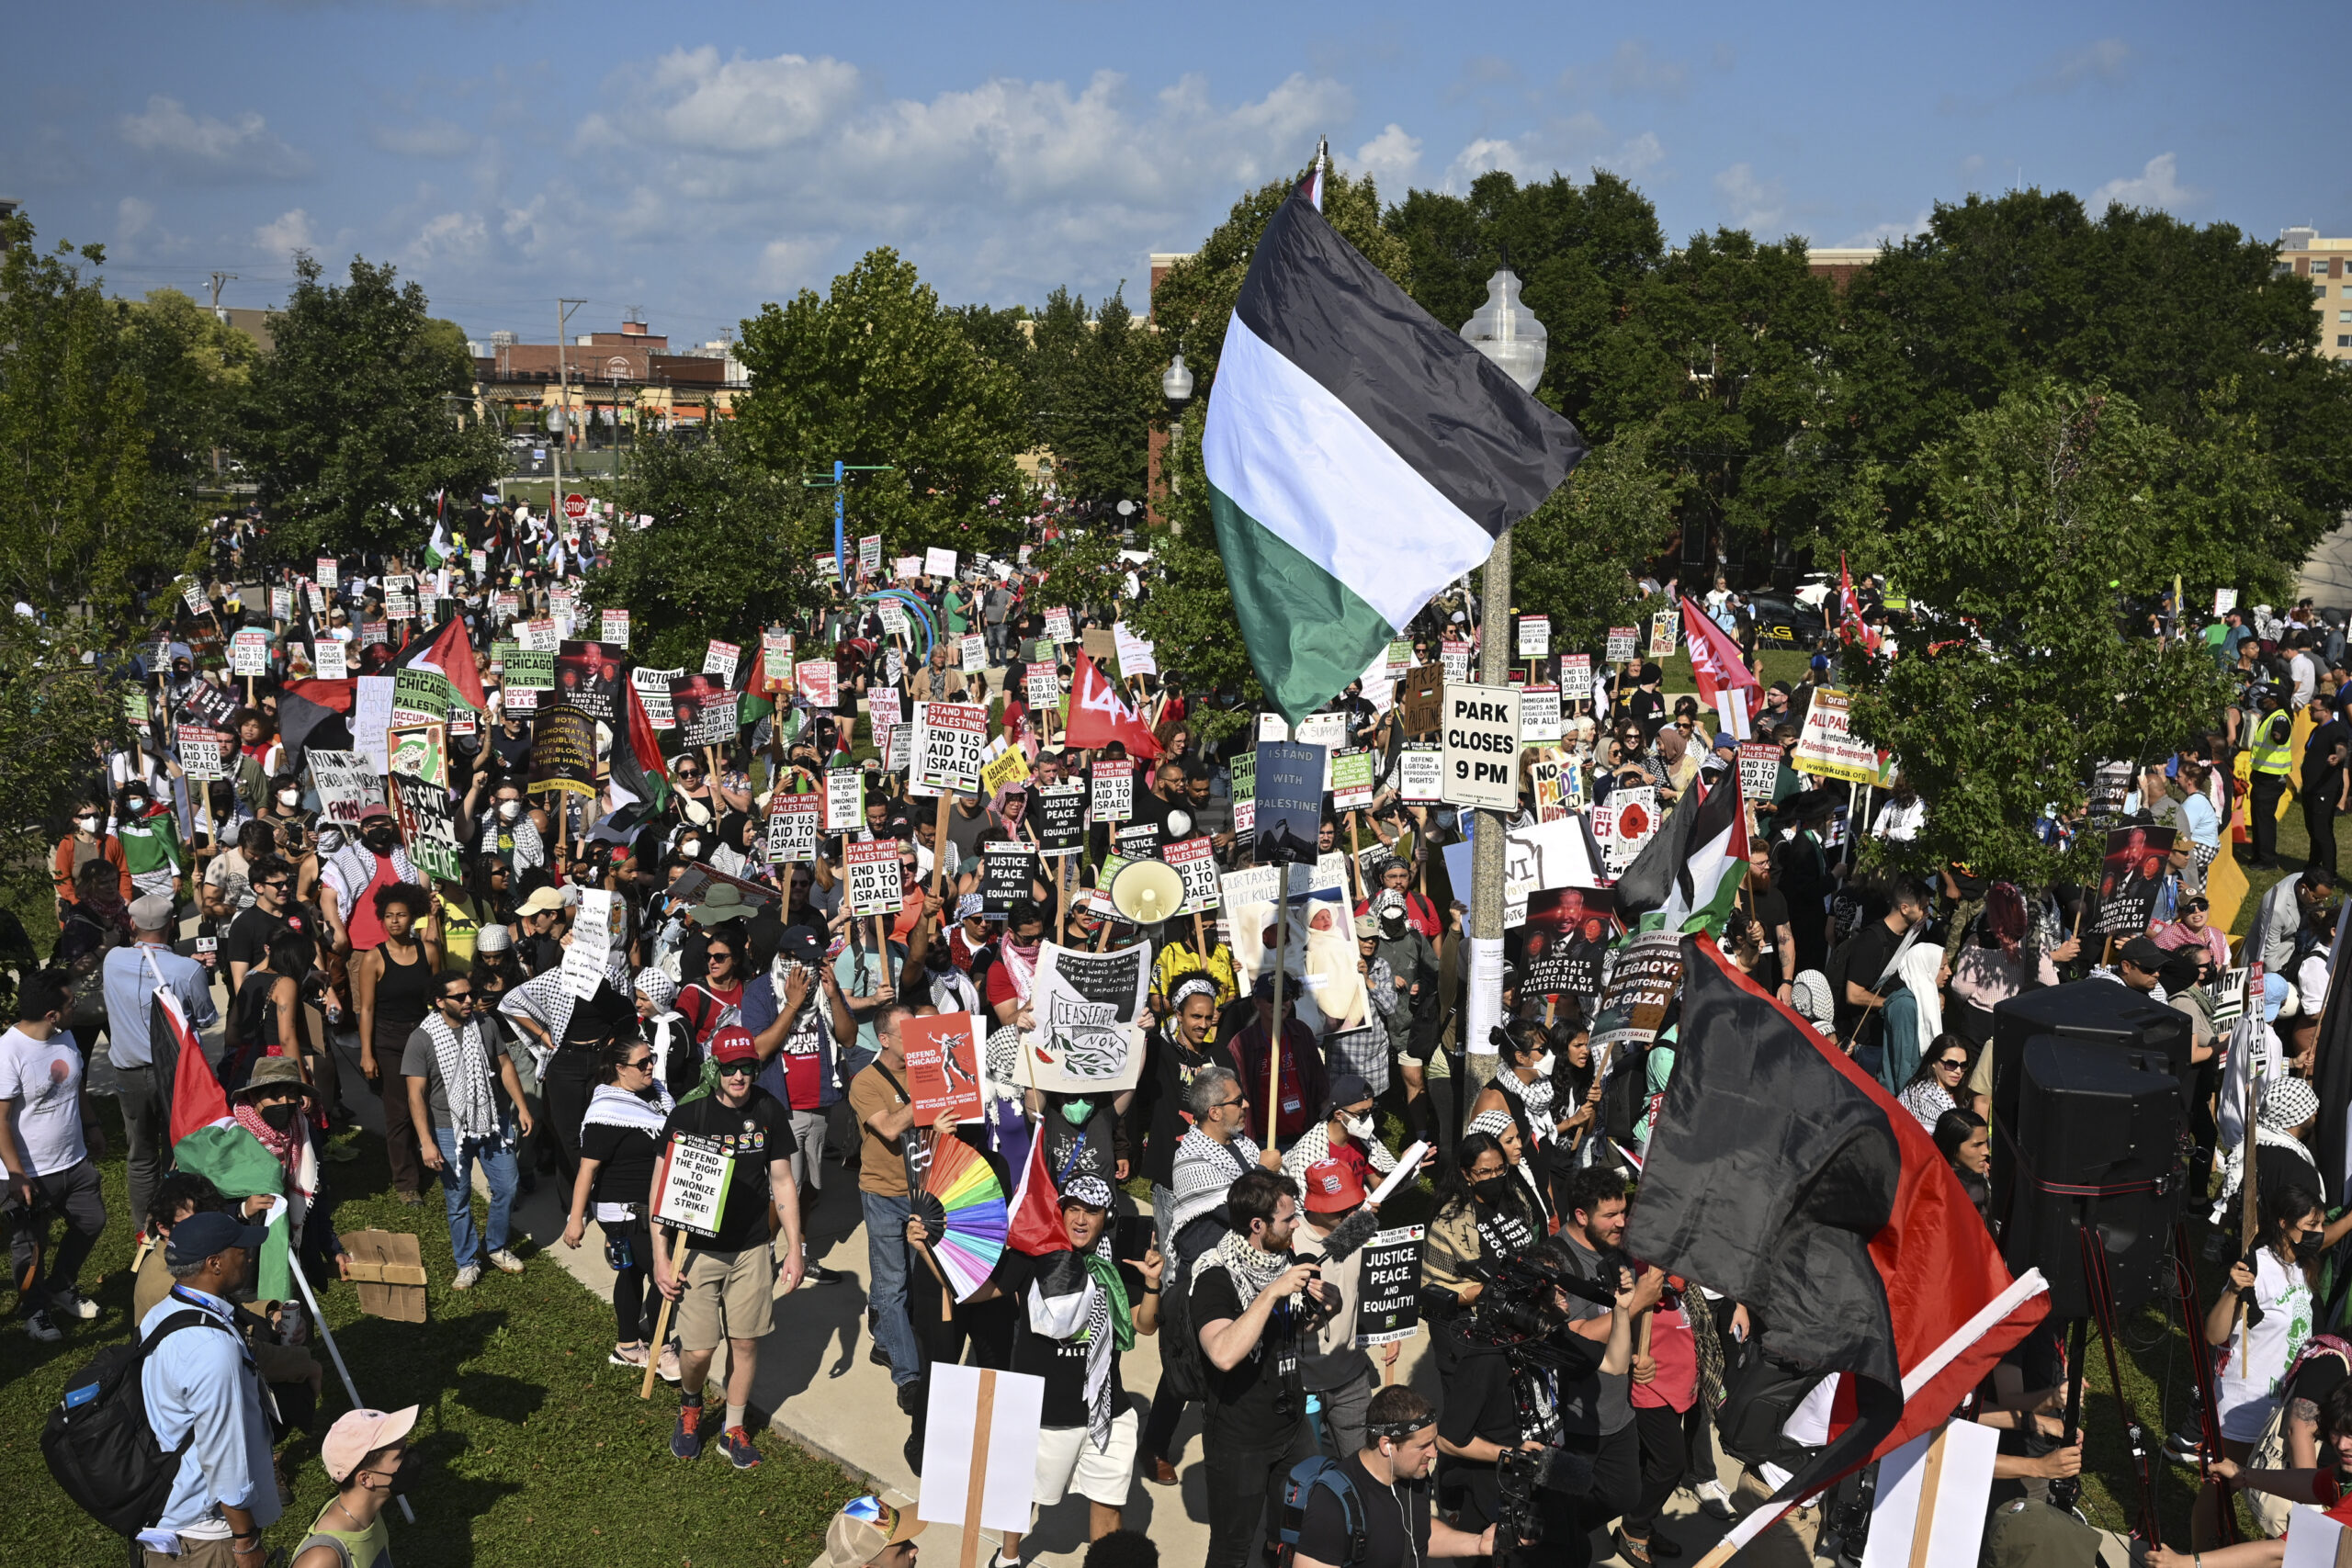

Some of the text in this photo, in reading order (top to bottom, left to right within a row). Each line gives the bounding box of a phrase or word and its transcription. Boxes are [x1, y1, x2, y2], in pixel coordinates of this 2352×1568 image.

[566, 502, 584, 513] STOP
[1656, 615, 1666, 624] NO
[505, 660, 552, 670] CHICAGO
[505, 677, 553, 686] PALESTINE
[1413, 662, 1445, 691] FREE
[397, 677, 447, 699] CHICAGO
[567, 693, 609, 701] DEMOCRATS
[1825, 694, 1847, 705] Torah
[395, 697, 445, 717] PALESTINE
[930, 705, 986, 720] STAND WITH
[1455, 700, 1508, 723] PARK
[707, 714, 734, 726] AID TO
[929, 716, 985, 731] PALESTINE!
[1809, 714, 1826, 728] ALL
[539, 737, 590, 750] REPUBLICANS
[930, 729, 979, 747] END U.S
[1449, 729, 1513, 754] CLOSES
[184, 751, 218, 761] AID TO
[534, 748, 594, 761] HAVE BLOOD ON
[928, 743, 979, 761] AID TO
[1270, 750, 1313, 761] I STAND
[1742, 751, 1780, 760] PALESTINE!
[1801, 739, 1873, 763] Palestinian Sovereignty
[185, 761, 219, 770] ISRAEL!
[538, 757, 590, 769] THEIR HANDS!
[927, 757, 978, 775] ISRAEL!
[988, 753, 1016, 781] ABANDON
[1093, 768, 1131, 777] PALESTINE!
[1456, 761, 1508, 784] 9 PM
[1536, 764, 1557, 781] NO
[1740, 770, 1774, 780] AID TO
[1806, 762, 1866, 781] www.nkusa.org
[1116, 779, 1129, 787] U.S
[1273, 773, 1302, 785] WITH
[1095, 788, 1129, 799] AID TO
[773, 796, 797, 805] STAND
[1043, 797, 1080, 808] JUSTICE.
[1095, 799, 1129, 809] ISRAEL!
[1258, 798, 1317, 812] PALESTINE
[1566, 795, 1578, 807] IN
[328, 799, 360, 820] FAMILY
[773, 803, 817, 812] PALESTINE!
[1047, 809, 1077, 819] PEACE.
[773, 815, 814, 826] END U.S
[772, 827, 792, 838] AID
[798, 826, 813, 836] TO
[1044, 827, 1080, 837] EQUALITY!
[771, 838, 812, 850] ISRAEL!
[847, 841, 896, 853] STAND WITH
[848, 851, 897, 863] PALESTINE!
[988, 857, 1029, 867] JUSTICE.
[851, 863, 896, 876] END U.S
[991, 869, 1024, 879] PEACE.
[853, 874, 898, 889] AID TO
[854, 887, 899, 901] ISRAEL!
[987, 890, 1027, 898] EQUALITY!
[2100, 898, 2144, 913] DEMOCRATS
[2103, 908, 2118, 919] FUND
[2087, 921, 2143, 933] PALESTINIANS
[2095, 914, 2128, 928] GENOCIDE
[1058, 954, 1069, 963] WE
[1091, 959, 1108, 967] FIND
[1621, 950, 1681, 961] GENOCIDE JOE'S
[1057, 962, 1074, 973] MAKE
[1124, 963, 1139, 973] WHICH
[1530, 960, 1590, 970] DEMOCRATS
[1615, 961, 1679, 978] LEGACY:
[1534, 967, 1583, 976] FUND THE
[1070, 975, 1135, 984] BOMBING FAMILIES
[1523, 975, 1574, 986] GENOCIDE
[1610, 979, 1672, 992] THE BUTCHER
[1094, 985, 1134, 993] IMPOSSIBLE
[1521, 983, 1593, 994] PALESTINIANS
[1602, 992, 1665, 1010] OF GAZA
[1057, 1003, 1115, 1026] CEASEFIRE
[724, 1037, 750, 1047] FRSO
[1084, 1035, 1118, 1048] NOW
[906, 1050, 935, 1059] DEFEND
[907, 1056, 942, 1066] CHICAGO
[687, 1134, 720, 1148] STAND WITH
[683, 1149, 718, 1165] DEFEND
[675, 1157, 722, 1177] THE RIGHT
[691, 1171, 702, 1181] TO
[673, 1176, 716, 1196] UNIONIZE
[682, 1190, 702, 1201] AND
[674, 1197, 709, 1213] STRIKE!
[1380, 1229, 1396, 1237] STAND
[1365, 1247, 1417, 1267] JUSTICE.
[1371, 1267, 1411, 1284] PEACE.
[1384, 1286, 1398, 1295] AND
[1363, 1295, 1413, 1313] EQUALITY!
